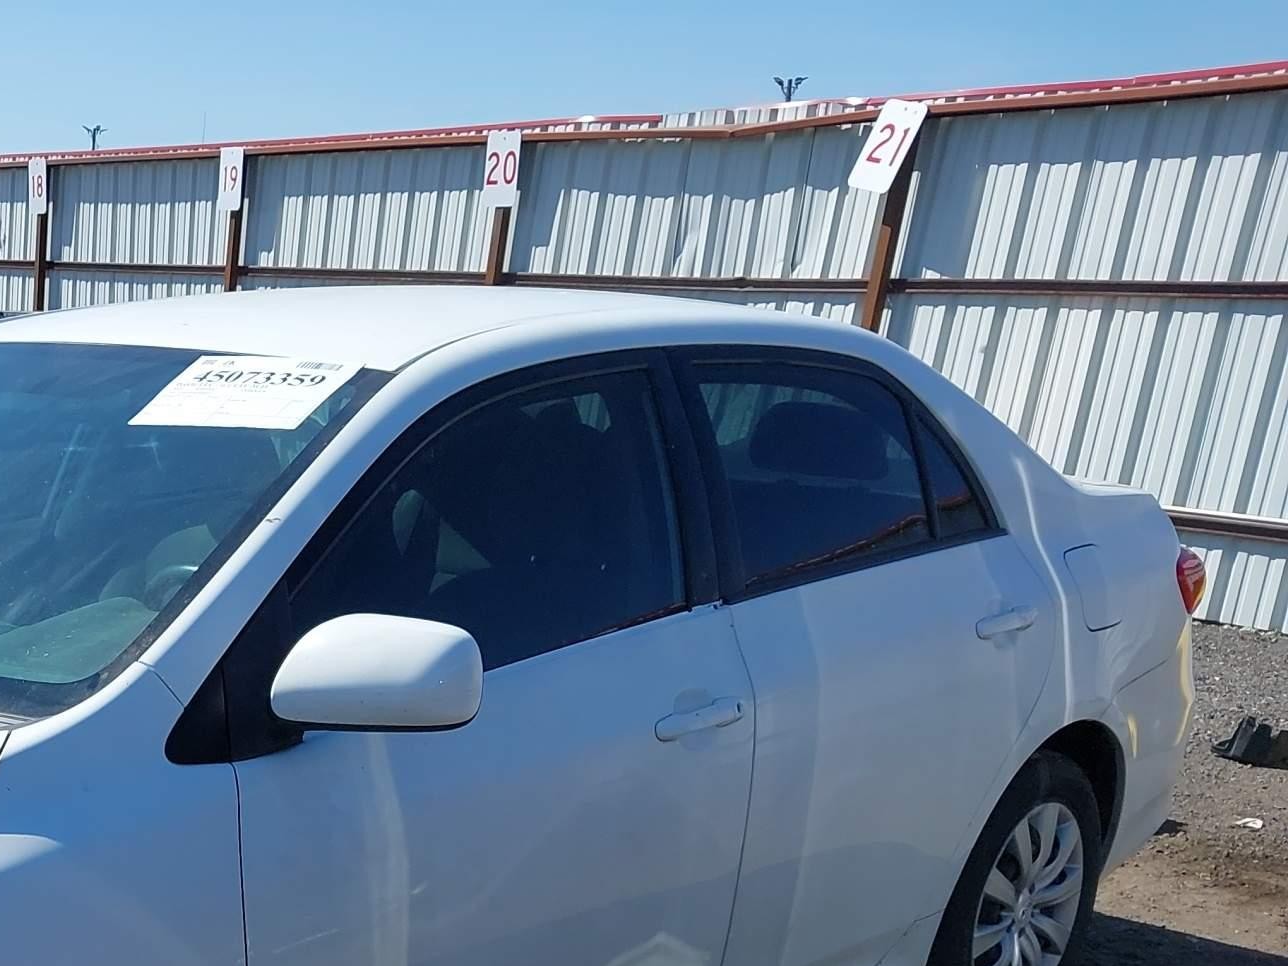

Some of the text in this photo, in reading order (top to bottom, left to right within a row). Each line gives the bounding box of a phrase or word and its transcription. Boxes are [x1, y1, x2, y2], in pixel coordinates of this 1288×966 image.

[865, 123, 911, 167] 21
[223, 165, 238, 192] 19
[486, 150, 517, 186] 20
[32, 174, 43, 198] 18
[193, 370, 326, 387] 45073359
